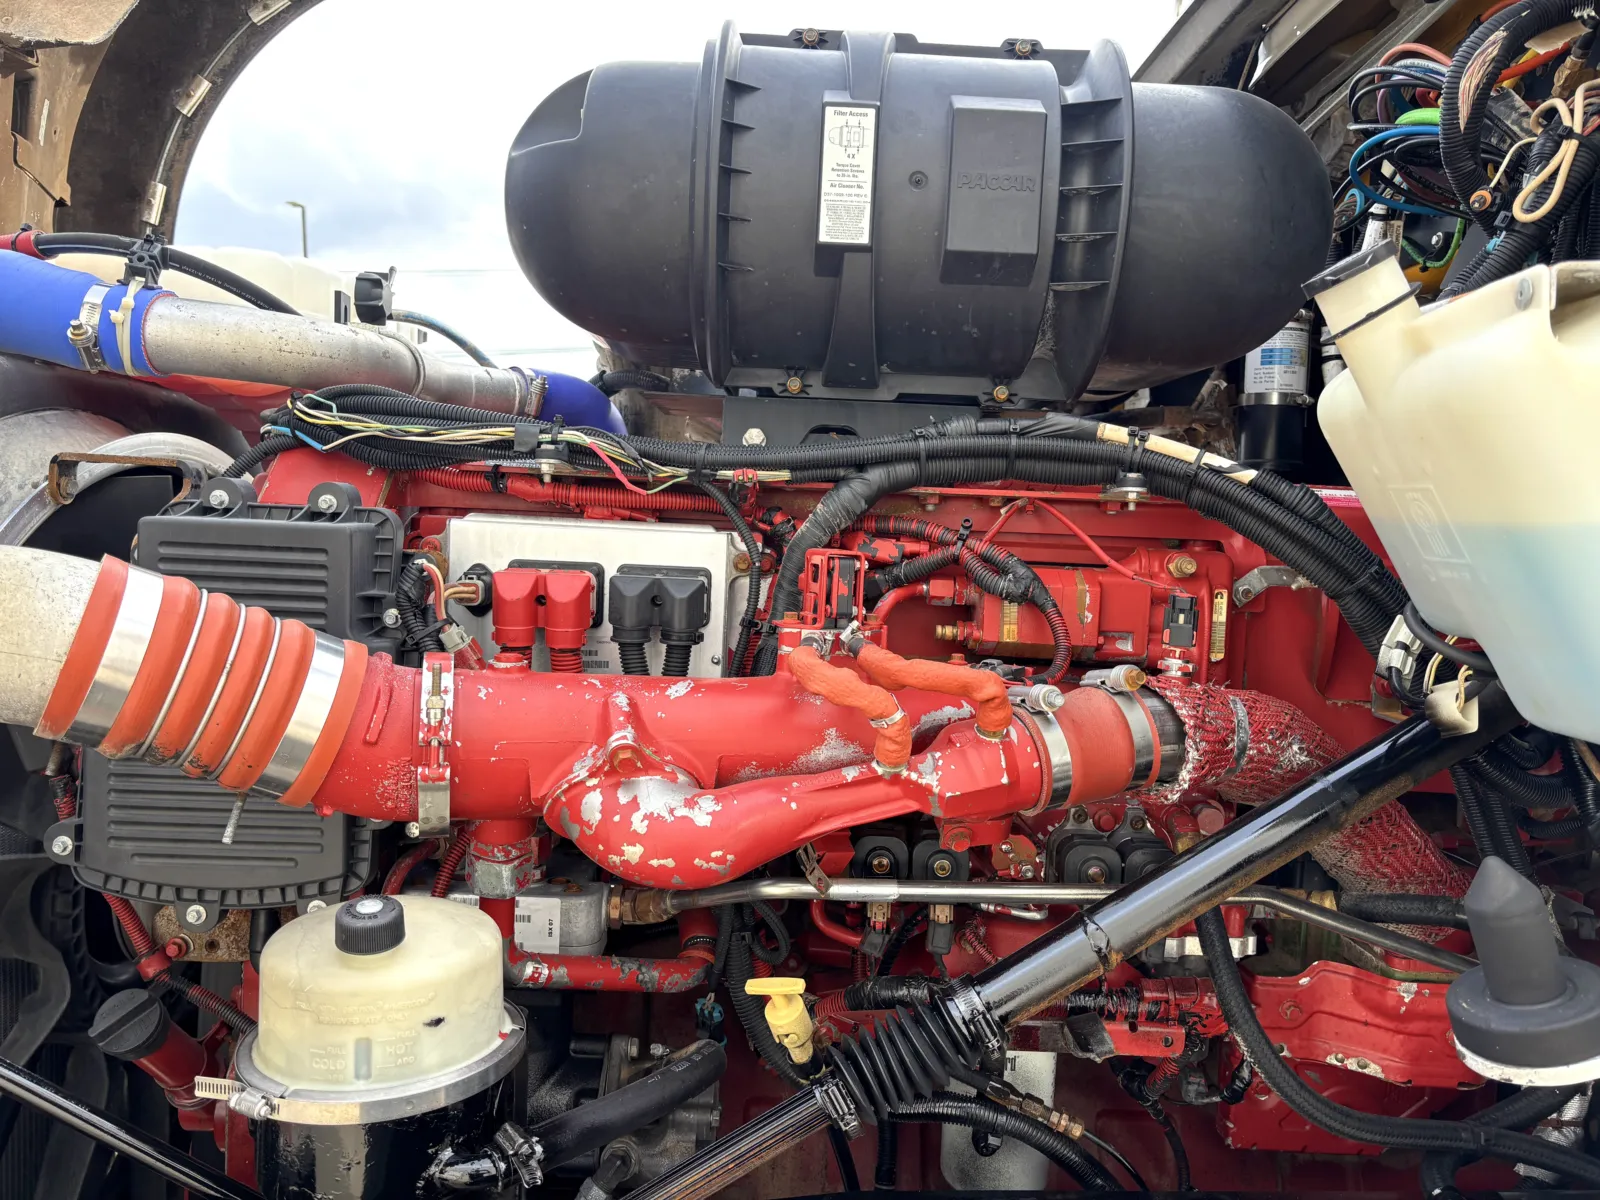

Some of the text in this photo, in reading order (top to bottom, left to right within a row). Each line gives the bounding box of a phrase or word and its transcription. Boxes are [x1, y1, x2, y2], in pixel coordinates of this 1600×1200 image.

[957, 172, 1036, 192] PACCAR
[326, 1046, 346, 1054] FULL
[386, 1042, 414, 1056] HOT
[312, 1058, 345, 1070] COLD
[396, 1056, 414, 1065] ADD
